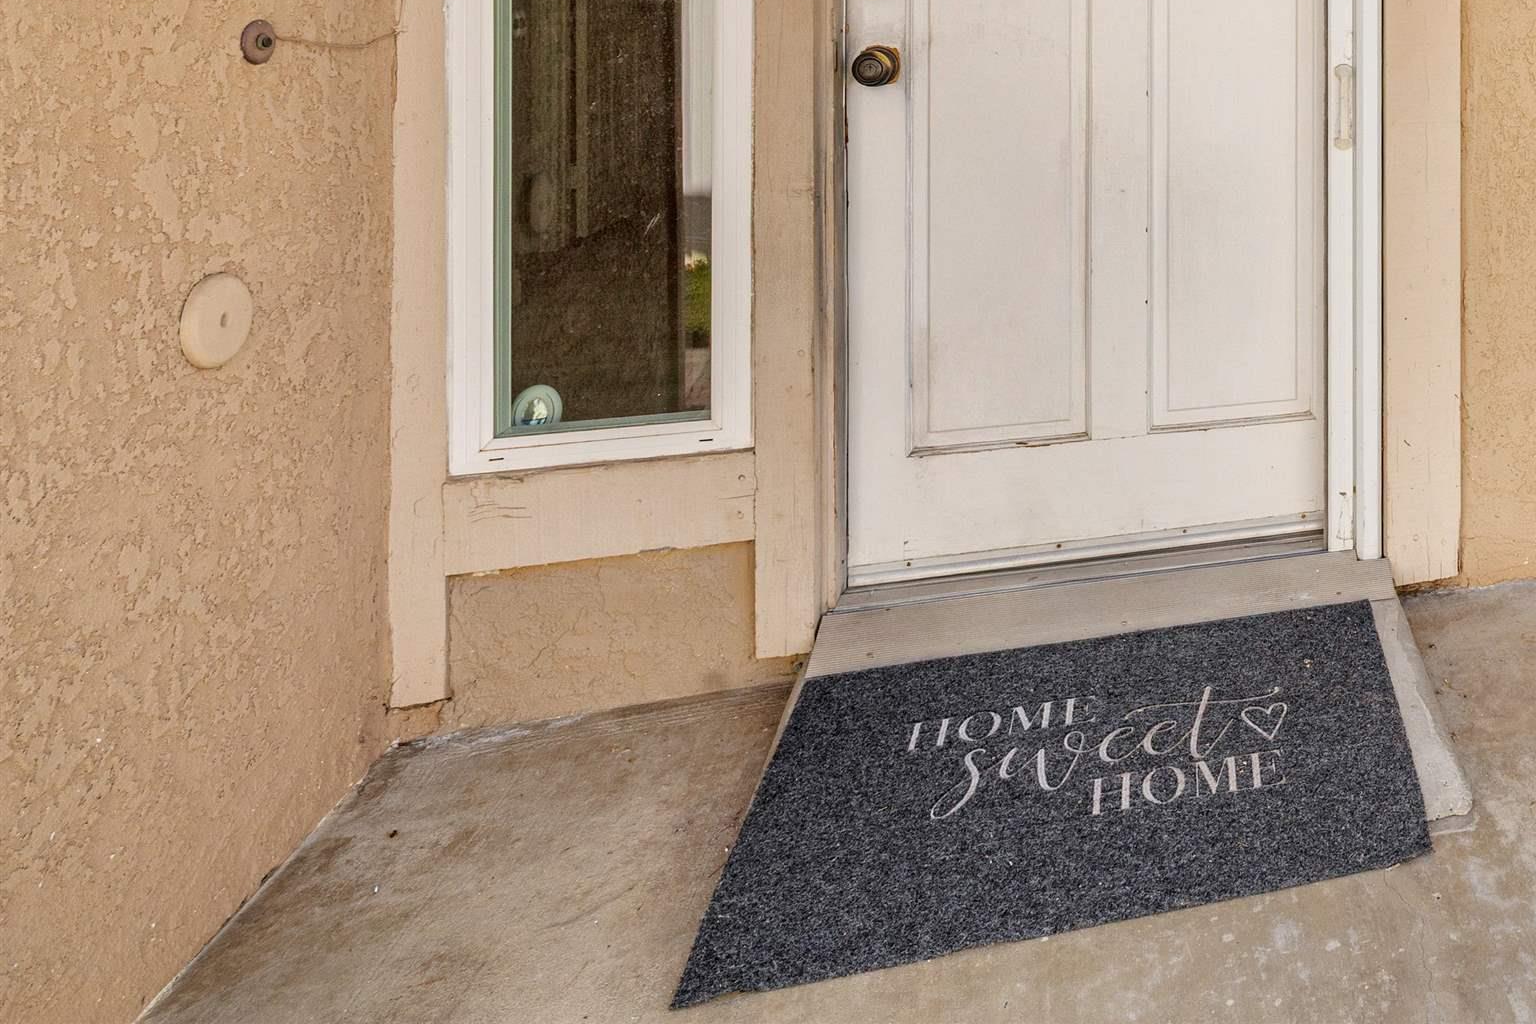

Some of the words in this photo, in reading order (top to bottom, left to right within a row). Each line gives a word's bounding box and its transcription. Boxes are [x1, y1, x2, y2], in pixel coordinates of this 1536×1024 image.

[907, 695, 1098, 752] HOME
[930, 685, 1280, 820] sweet
[1091, 748, 1286, 816] HOME
